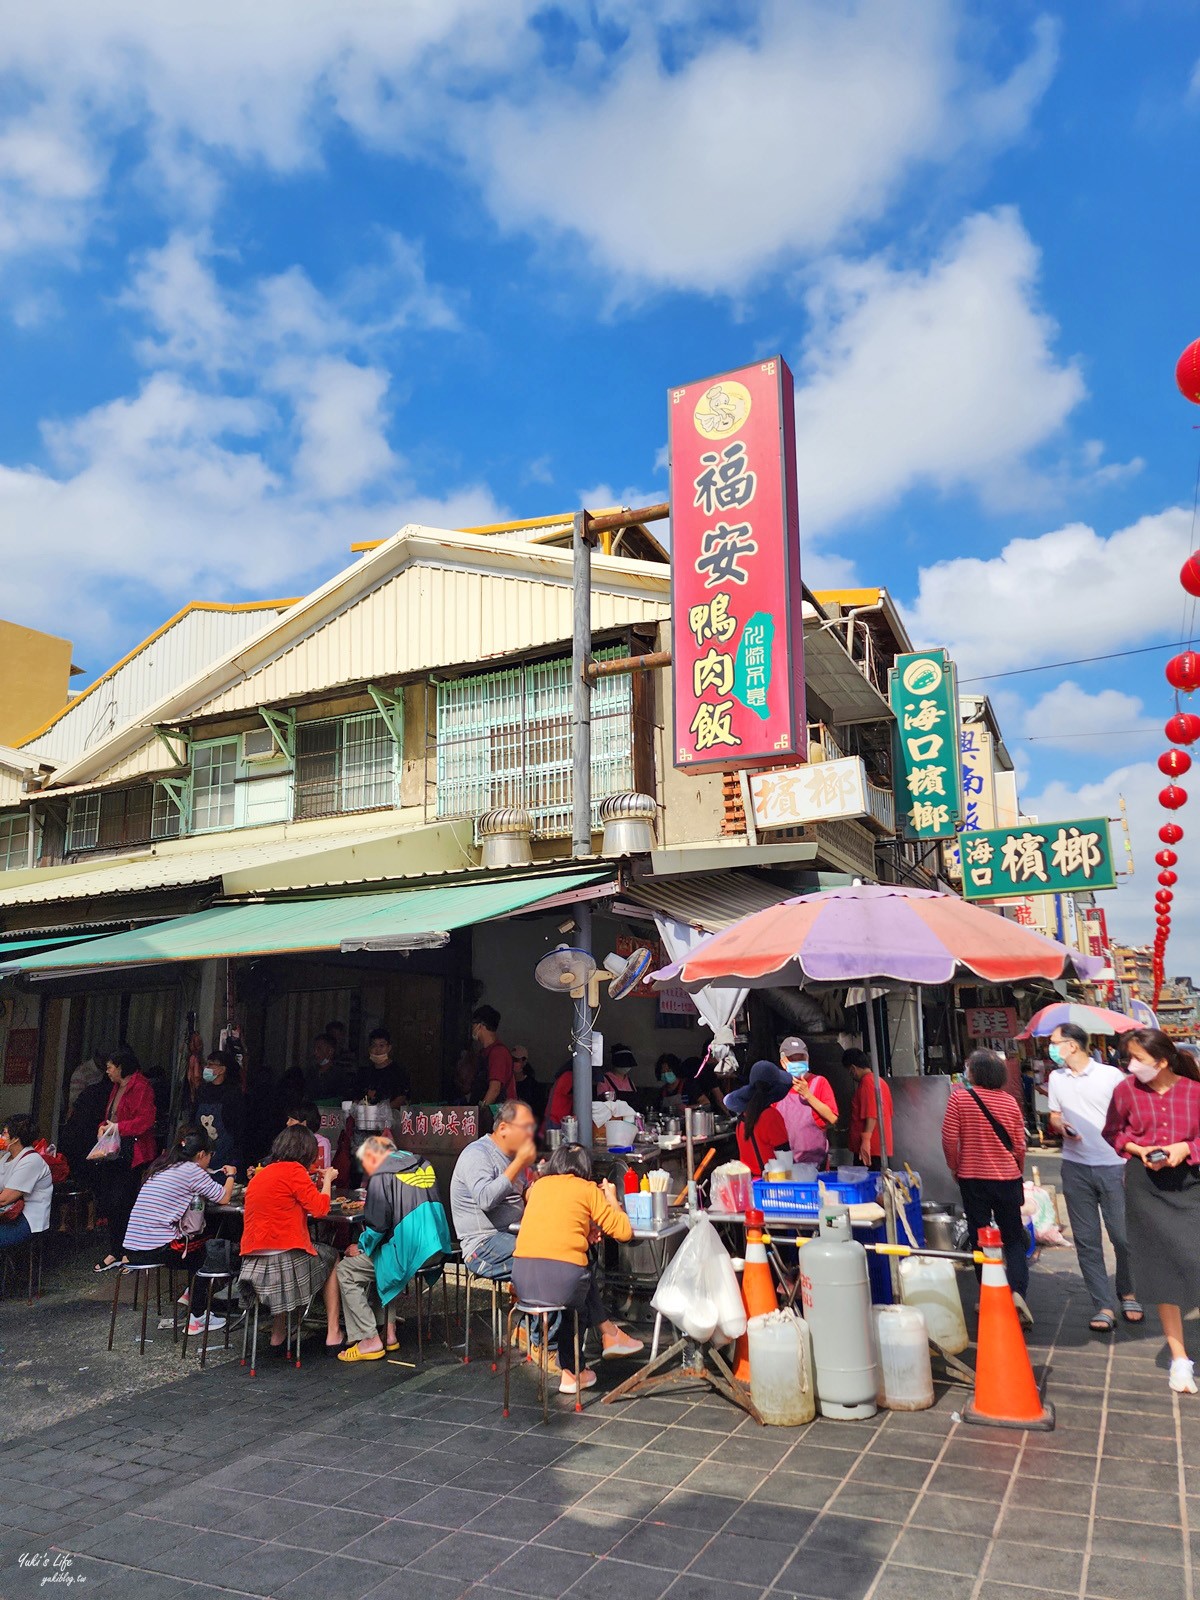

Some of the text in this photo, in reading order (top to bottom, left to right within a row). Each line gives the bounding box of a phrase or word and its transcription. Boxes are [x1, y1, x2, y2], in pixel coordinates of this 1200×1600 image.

[754, 766, 857, 819] 檳榔
[904, 699, 951, 833] 海口檳榔
[965, 837, 995, 887] 海口
[1000, 827, 1102, 884] 檳榔
